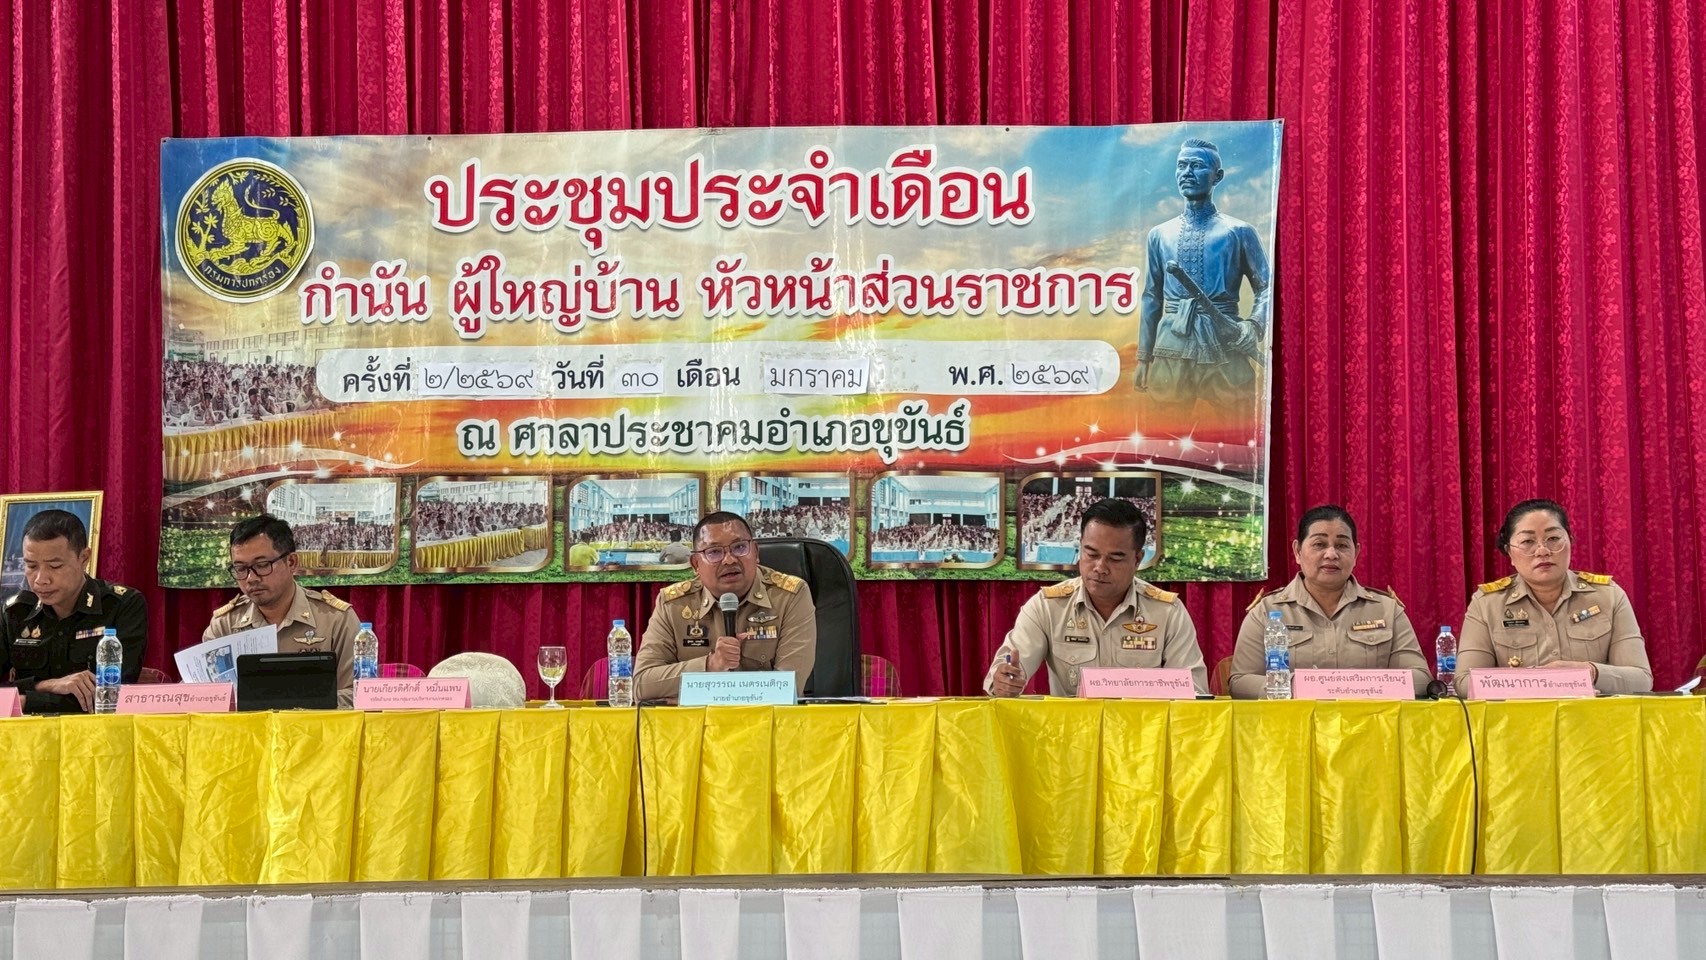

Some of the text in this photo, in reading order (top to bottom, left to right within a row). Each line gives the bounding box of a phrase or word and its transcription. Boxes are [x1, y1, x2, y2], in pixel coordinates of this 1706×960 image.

[430, 148, 1031, 249] ประชุมประจำเดือน
[204, 265, 282, 289] กรมการปกครอง
[304, 255, 1133, 334] กำนัน ผู้ใหญ่บ้าน หัวหน้าส่วนราชการ
[343, 354, 1090, 393] ครั้งที่ ๒/๒๕๖๙ วันที่ ๓๐ เดือน มกราคม พ.ศ. ๒๕๖๙
[461, 403, 966, 460] ณ ศาลาประชาคมอำเภอขุขันธ์
[686, 681, 736, 691] นายสุวรรณ
